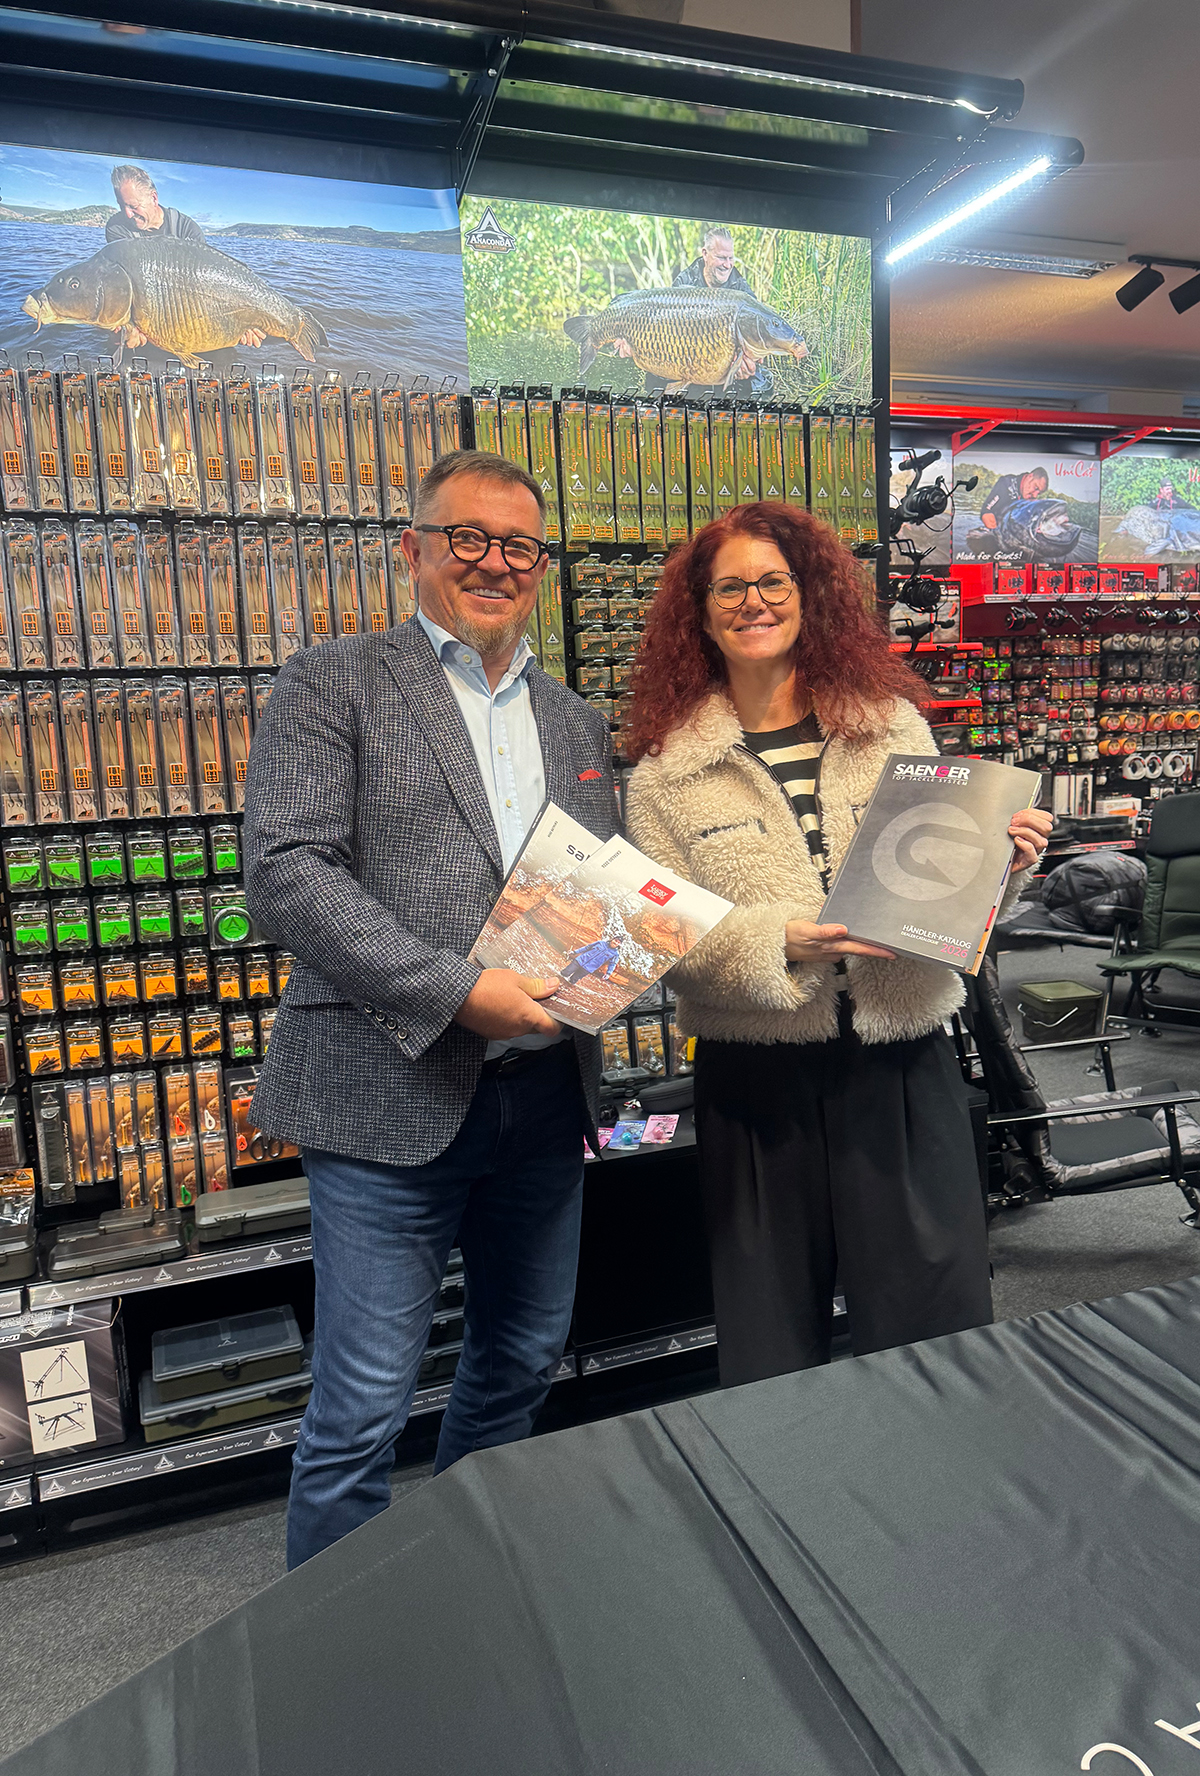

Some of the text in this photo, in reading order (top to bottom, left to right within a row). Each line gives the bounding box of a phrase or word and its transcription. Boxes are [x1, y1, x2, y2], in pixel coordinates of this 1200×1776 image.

[470, 234, 512, 247] ANACONDA
[1054, 460, 1098, 478] UniCat
[955, 550, 1023, 561] Made for Giants!
[893, 763, 971, 779] SAENGER
[938, 777, 968, 786] SYSTEM
[902, 924, 973, 950] HÄNDLER-KATALOG
[940, 943, 969, 959] 2026
[196, 1262, 219, 1273] Experience
[234, 1255, 251, 1265] Victory!
[86, 1282, 109, 1293] Experience
[124, 1275, 143, 1285] Victory!
[195, 1448, 218, 1459] Experience
[233, 1439, 253, 1449] Victory!
[71, 1477, 82, 1485] Our
[82, 1472, 107, 1484] Experience
[123, 1464, 144, 1474] Victory!
